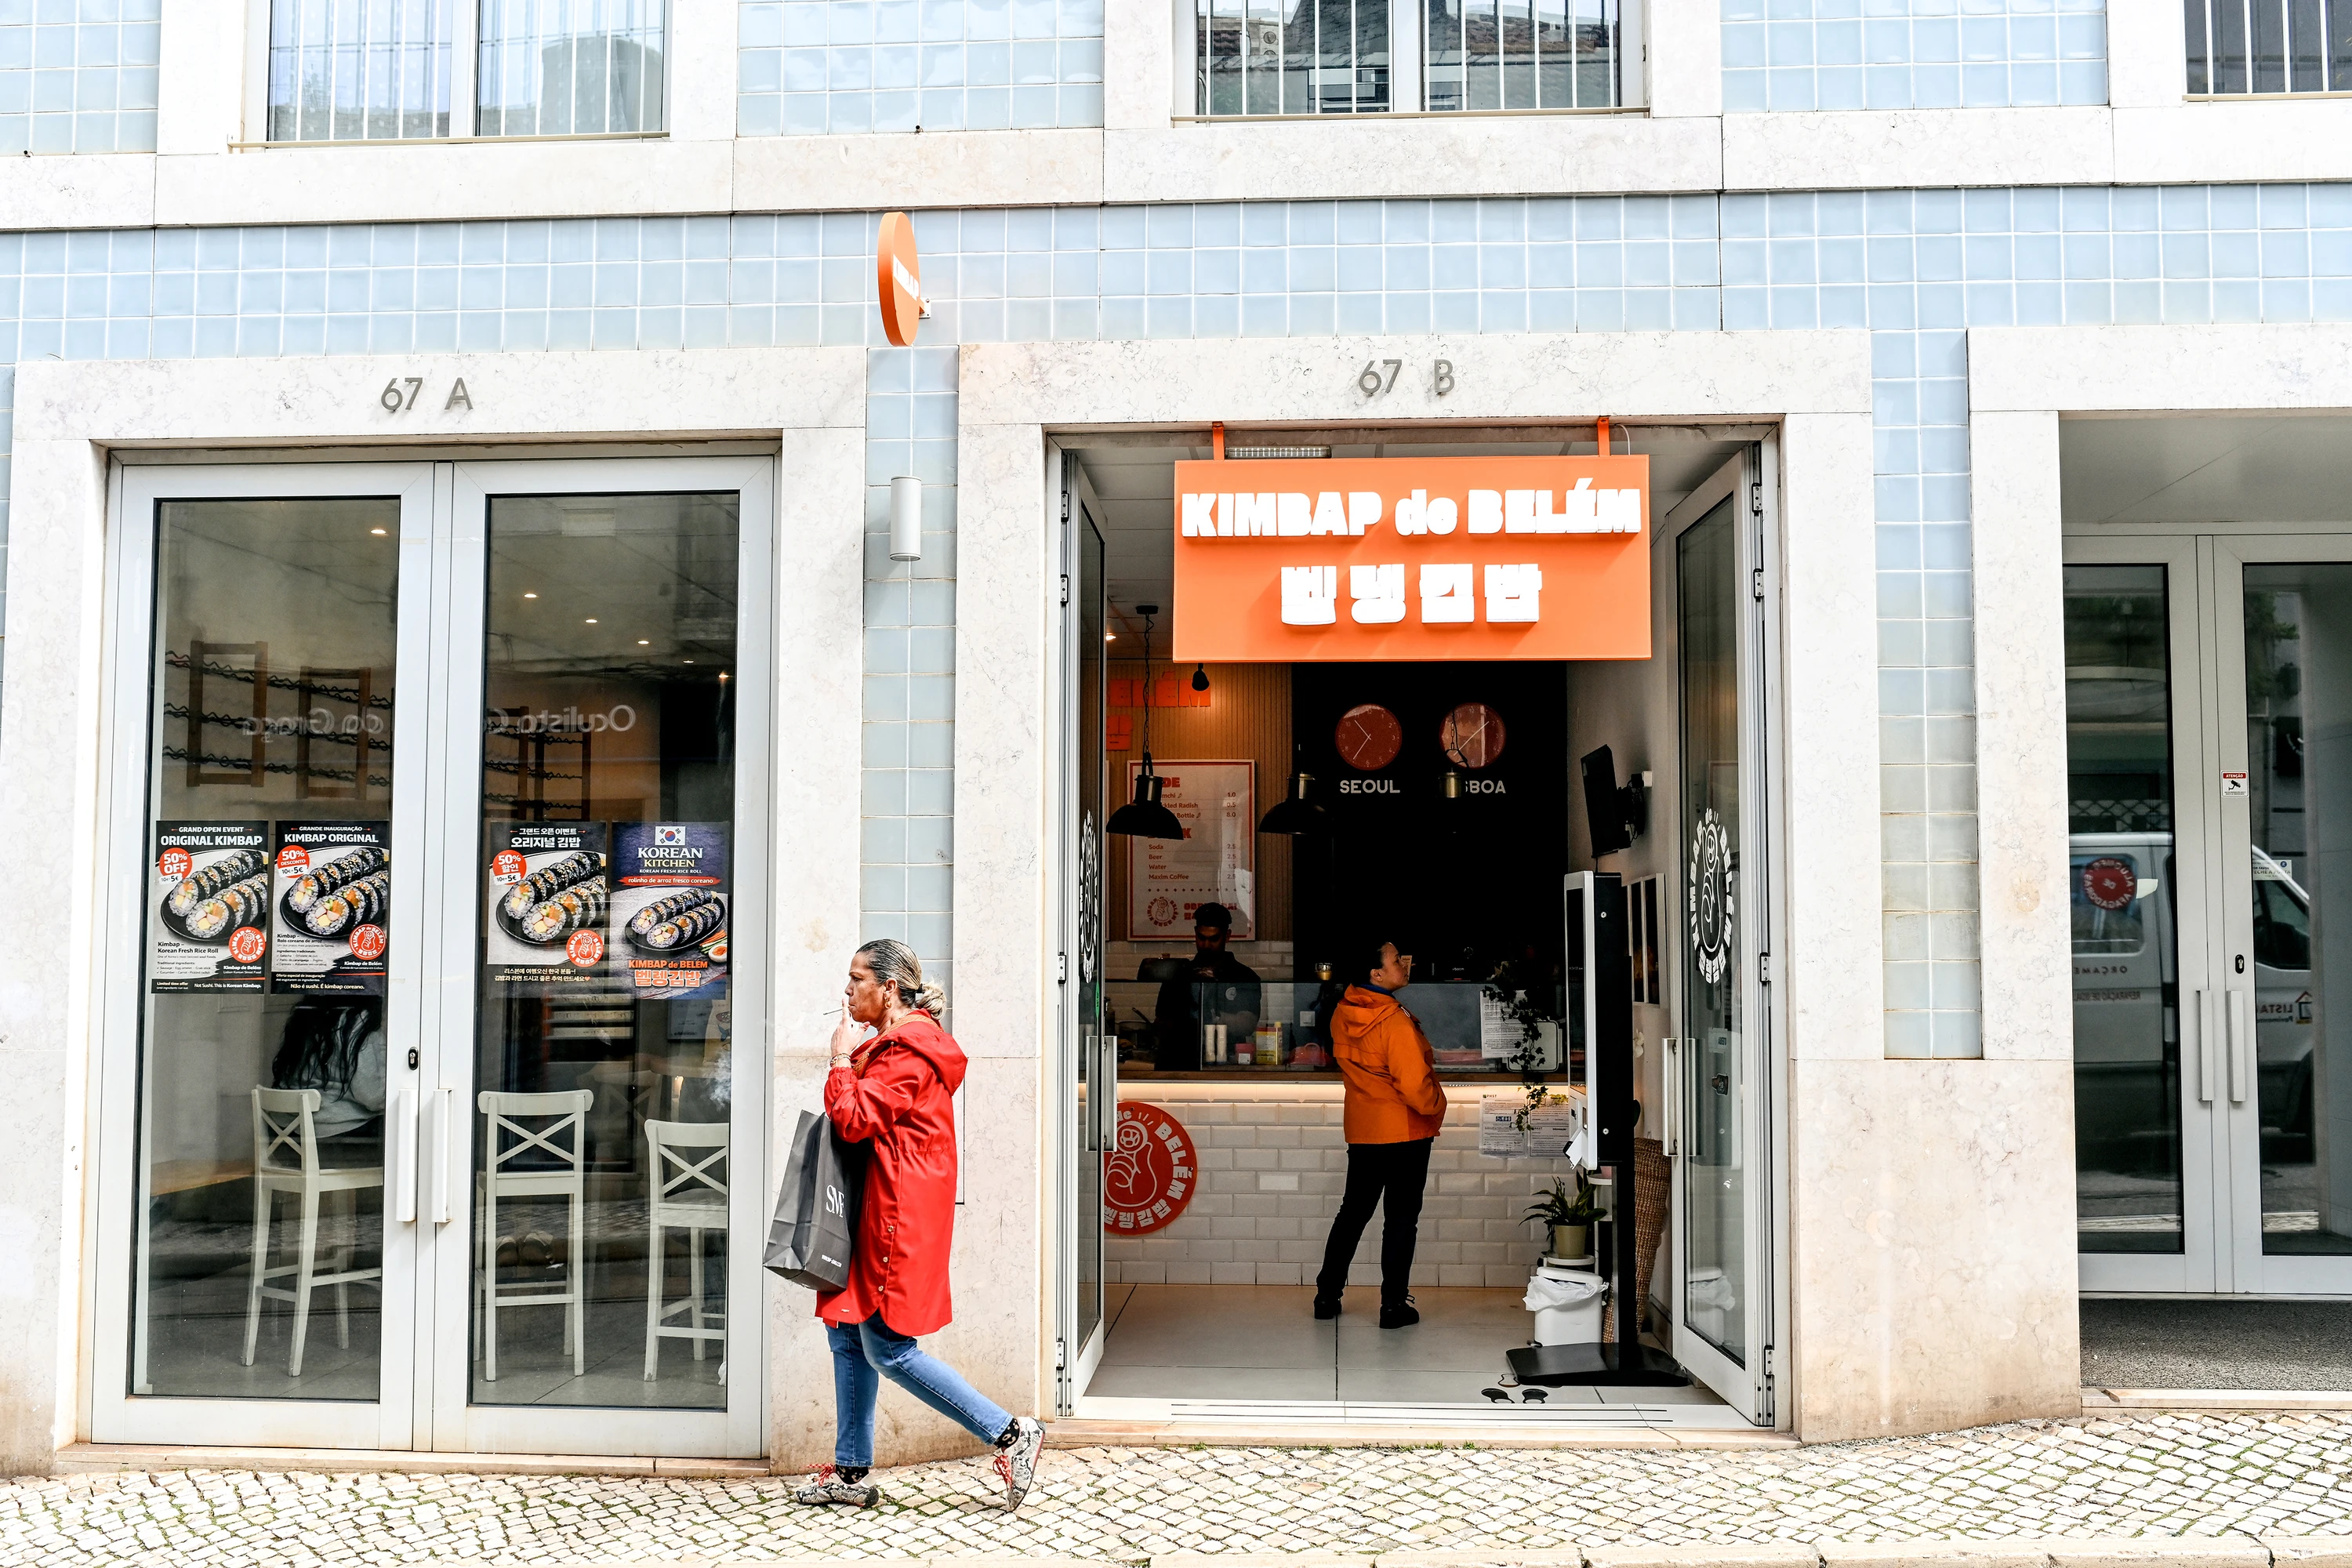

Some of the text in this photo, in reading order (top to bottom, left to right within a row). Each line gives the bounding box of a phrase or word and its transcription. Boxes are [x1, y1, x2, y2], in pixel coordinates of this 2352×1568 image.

[1358, 359, 1455, 394] 67 B
[380, 377, 474, 411] 67 A
[1181, 477, 1642, 537] KIMBAP de BELÉM
[1163, 777, 1181, 788] DE
[1339, 779, 1401, 793] SEOUL
[1465, 779, 1506, 794] BOA
[160, 835, 263, 846] ORIGINAL KIMBAP
[285, 833, 379, 843] KIMBAP ORIGINAL
[510, 837, 581, 848] 오리지널 김밥
[163, 852, 187, 865] 50%
[282, 850, 305, 861] 50%
[637, 847, 703, 858] KOREAN
[498, 854, 521, 866] 50%
[644, 859, 695, 868] KITCHEN
[164, 862, 188, 874] OFF
[501, 863, 519, 873] 할인
[628, 960, 668, 968] KIMBAP
[680, 959, 708, 968] BELÉM
[634, 969, 701, 987] 벨렝김밥
[1155, 1121, 1192, 1200] BELÉM
